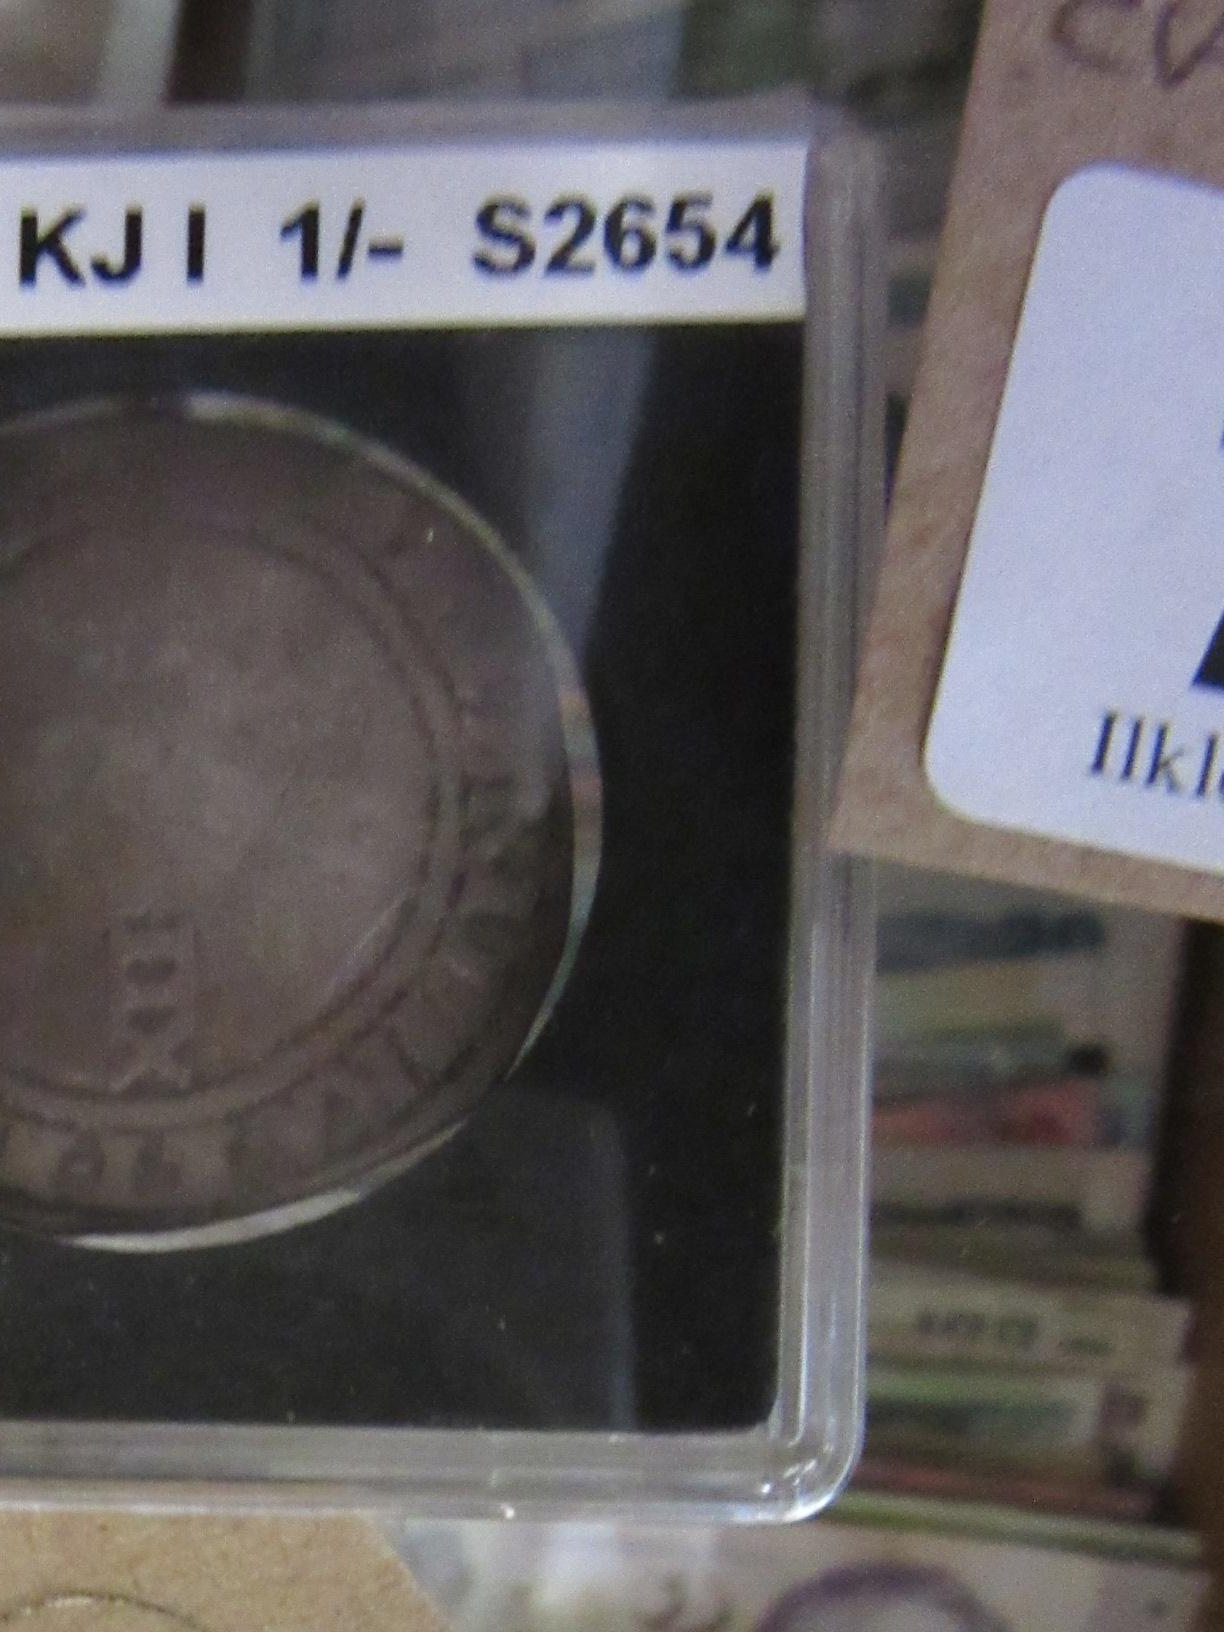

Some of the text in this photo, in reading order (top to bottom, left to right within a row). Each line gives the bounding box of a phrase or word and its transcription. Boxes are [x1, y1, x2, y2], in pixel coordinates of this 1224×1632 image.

[280, 203, 403, 281] 1/-
[471, 194, 780, 279] S2654
[1091, 711, 1224, 798] Ilkl
